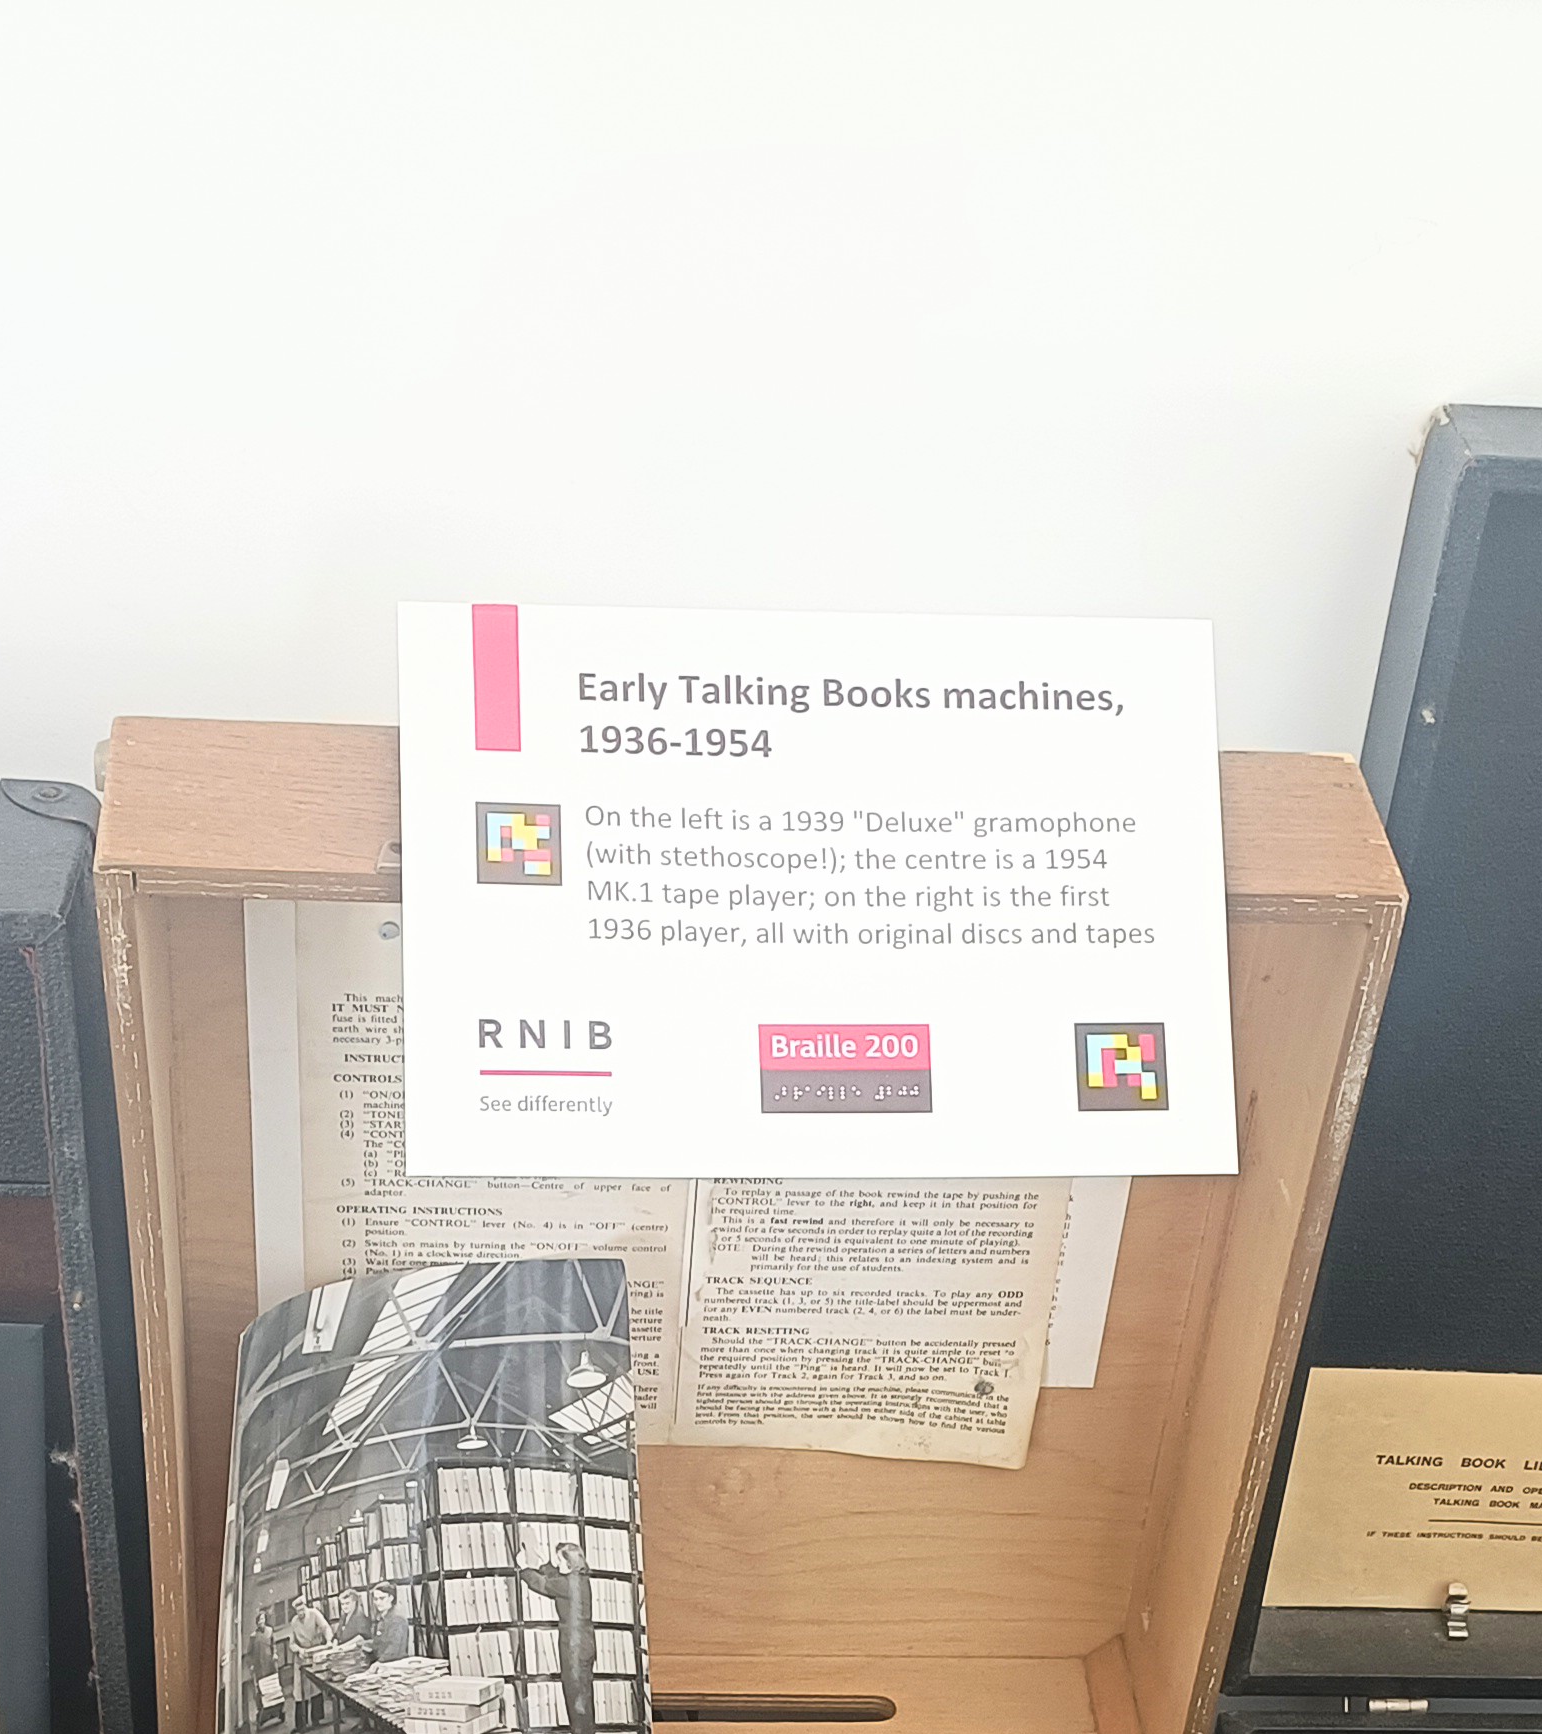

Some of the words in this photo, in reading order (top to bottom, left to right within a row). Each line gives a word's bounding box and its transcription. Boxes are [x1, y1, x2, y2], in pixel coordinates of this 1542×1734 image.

[579, 672, 667, 709] Early
[678, 674, 809, 713] Talking
[823, 678, 930, 708] Books
[943, 680, 1122, 716] machines,
[580, 725, 771, 757] 1936-1954
[585, 805, 620, 826] On
[630, 806, 671, 828] the
[681, 807, 722, 829] left
[732, 809, 749, 830] is
[759, 815, 771, 830] a
[782, 810, 843, 831] 1939
[853, 810, 963, 832] "Deluxe"
[974, 811, 1135, 837] gramophone
[586, 841, 650, 867] (with
[660, 845, 844, 874] stethoscope!);
[854, 848, 895, 869] the
[905, 851, 985, 869] centre
[996, 849, 1013, 868] is
[1022, 853, 1034, 869] a
[1045, 848, 1107, 869] 1954
[588, 880, 652, 902] MK.1
[662, 884, 718, 908] tape
[729, 884, 813, 911] player;
[825, 891, 855, 906] on
[864, 885, 905, 906] the
[916, 885, 973, 911] right
[983, 886, 1000, 906] is
[1010, 885, 1050, 906] the
[1060, 885, 1109, 906] first
[589, 918, 651, 940] 1936
[661, 919, 745, 947] player,
[756, 922, 782, 943] all
[793, 923, 847, 943] with
[858, 922, 951, 949] original
[961, 922, 1021, 943] discs
[1031, 922, 1076, 943] and
[1085, 924, 1154, 948] tapes
[478, 1019, 612, 1050] RNIB
[770, 1034, 857, 1059] Braille
[864, 1034, 919, 1059] 200
[479, 1096, 511, 1112] See
[517, 1095, 612, 1117] differently
[723, 1187, 737, 1195] To
[741, 1188, 770, 1197] replay
[784, 1190, 821, 1198] passage
[887, 1190, 919, 1198] rewind
[924, 1190, 938, 1198] the
[942, 1192, 963, 1200] tape
[967, 1191, 979, 1200] by
[982, 1191, 1020, 1201] pushing
[336, 1205, 406, 1213] OPERATING
[412, 1206, 502, 1215] INSTRUCTIONS
[705, 1276, 743, 1284] TRACK
[750, 1277, 812, 1285] SEQUENCE
[702, 1326, 739, 1334] TRACK
[1376, 1454, 1443, 1466] TALKING
[1460, 1457, 1505, 1468] BOOK
[1408, 1482, 1482, 1491] DESCRIPTION
[1433, 1497, 1479, 1506] TALKING
[1489, 1500, 1520, 1508] BOOK
